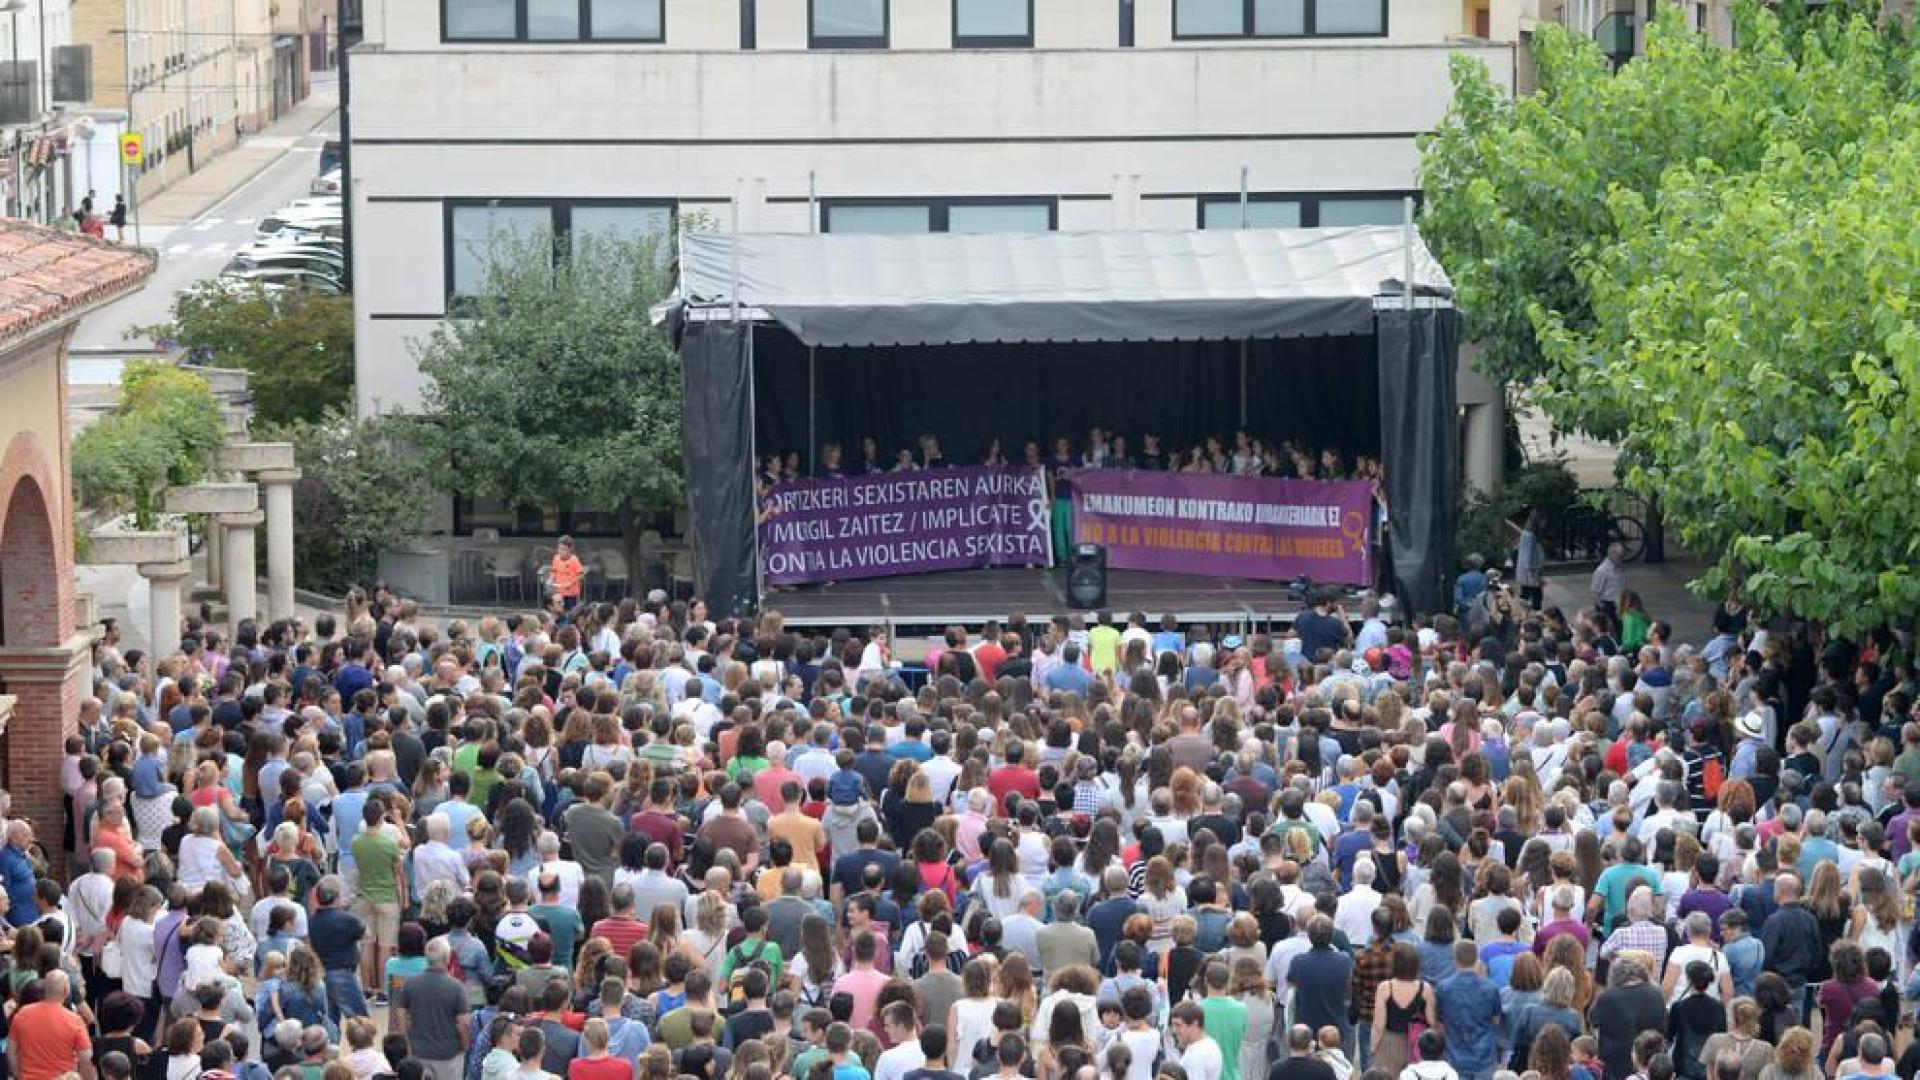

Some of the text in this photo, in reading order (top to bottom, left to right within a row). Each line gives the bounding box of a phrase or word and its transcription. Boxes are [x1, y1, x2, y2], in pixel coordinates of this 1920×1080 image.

[853, 477, 969, 506] SEXISTAREN
[975, 474, 1041, 496] AURKA
[839, 512, 904, 537] ZAITEZ
[911, 511, 917, 532] /
[761, 533, 1042, 574] ONTA LA VIOLENCIA SEXISTA
